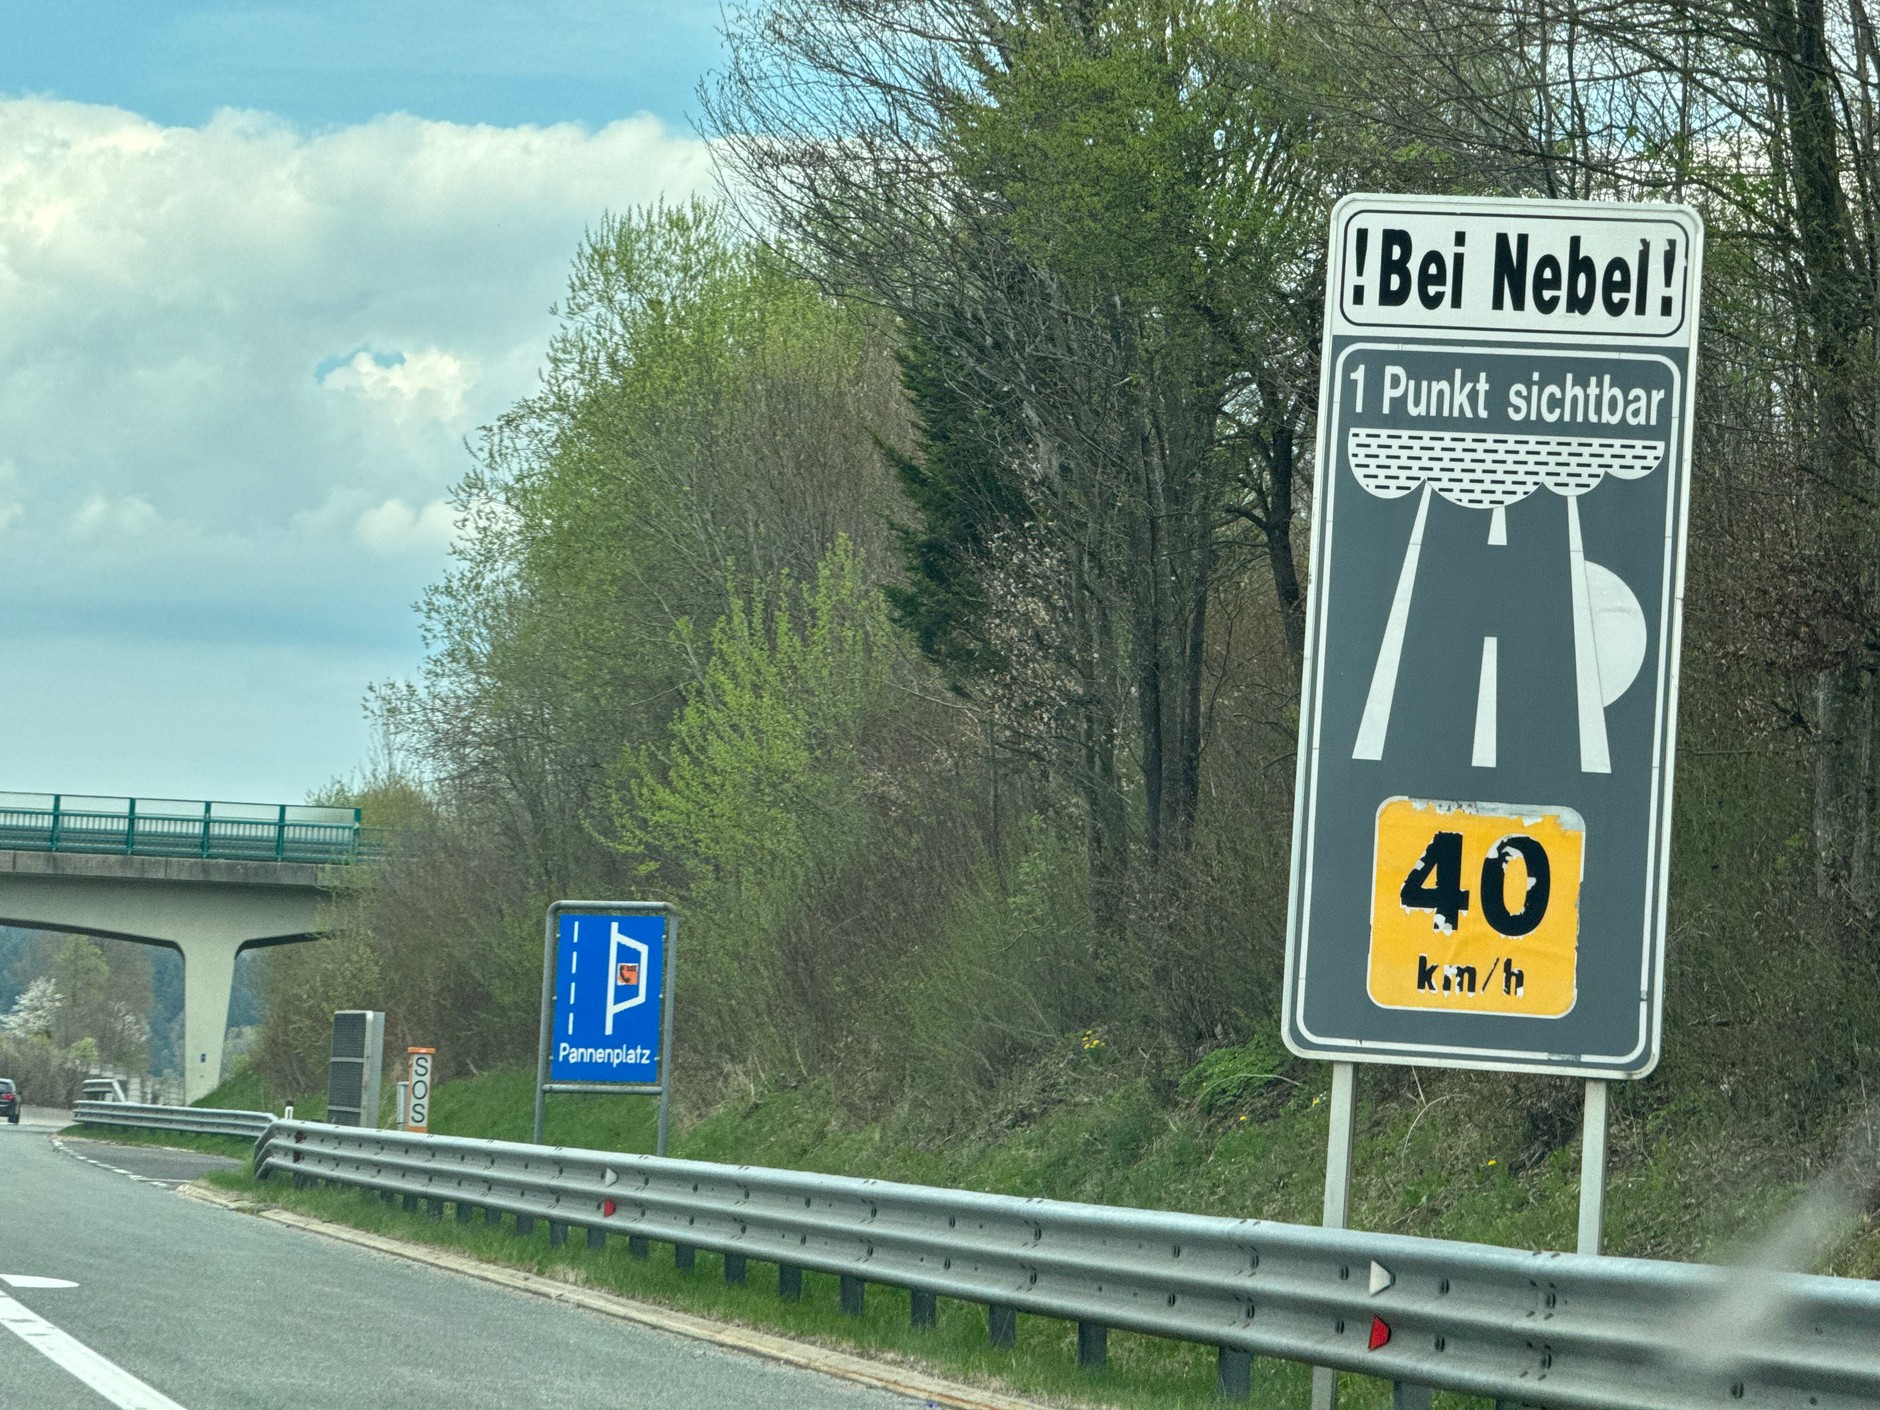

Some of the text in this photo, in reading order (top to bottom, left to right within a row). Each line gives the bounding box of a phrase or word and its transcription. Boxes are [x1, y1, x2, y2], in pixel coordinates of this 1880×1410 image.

[1349, 364, 1665, 426] 1 Punkt sichtbar
[1400, 830, 1551, 938] 40
[1416, 954, 1525, 997] km/h
[558, 1042, 651, 1068] Pannenplatz
[411, 1056, 429, 1124] SOS
